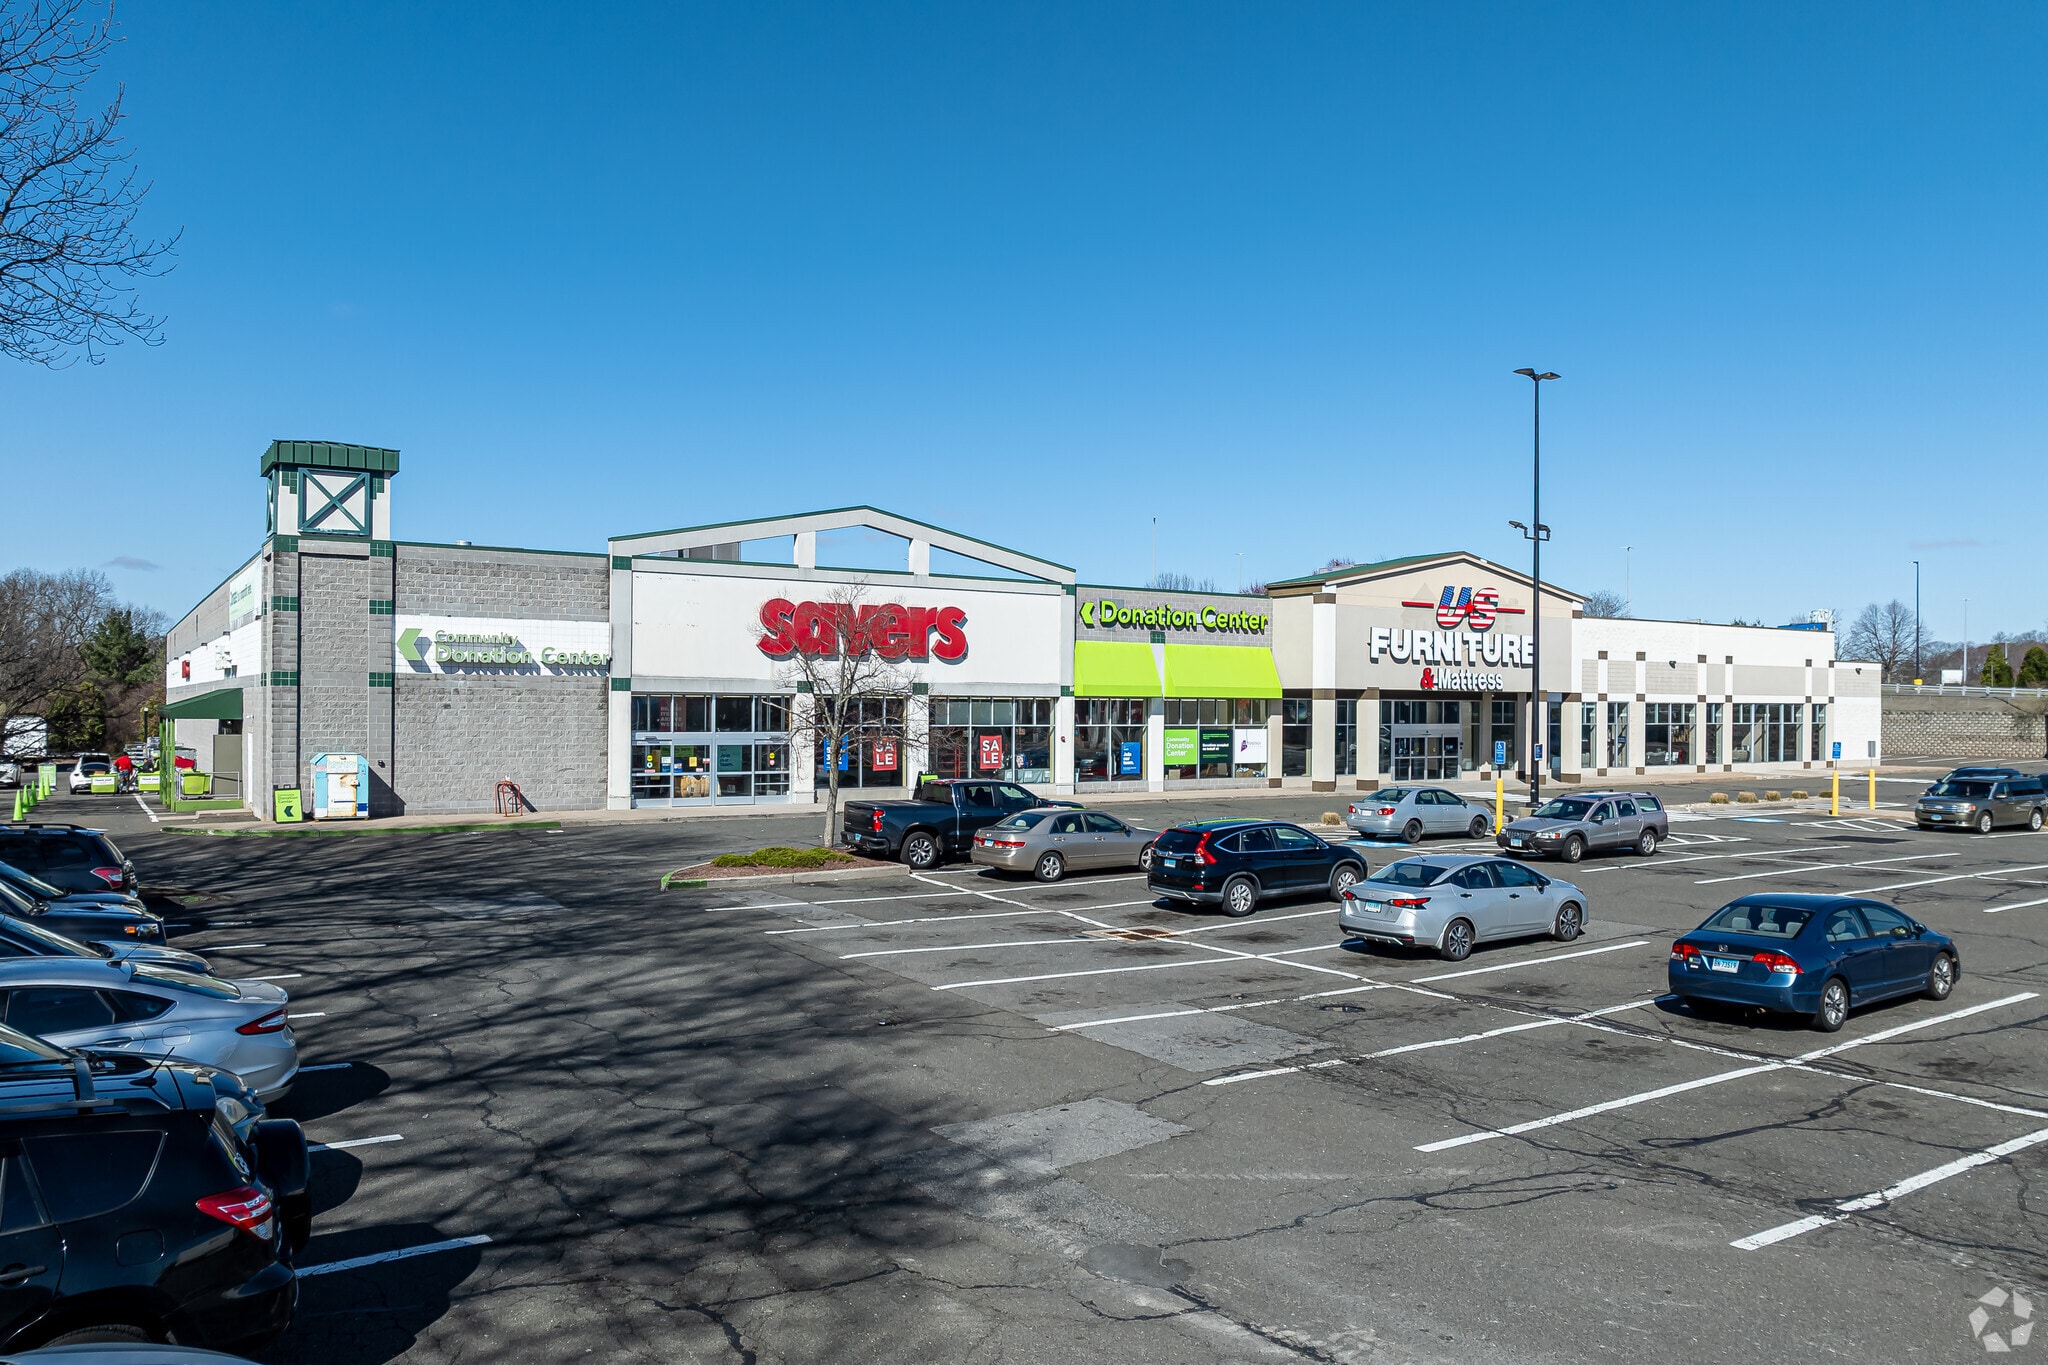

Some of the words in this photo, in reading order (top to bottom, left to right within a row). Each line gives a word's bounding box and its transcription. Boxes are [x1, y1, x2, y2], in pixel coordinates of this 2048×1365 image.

[1101, 600, 1197, 626] Donation
[1202, 605, 1269, 630] Center
[1436, 585, 1500, 630] US
[435, 630, 518, 647] Community
[1370, 626, 1534, 666] FURNITURE
[435, 644, 533, 664] Donation
[541, 646, 611, 665] Center
[982, 740, 1000, 751] SA
[1166, 749, 1187, 757] Center
[876, 753, 894, 766] LE
[982, 752, 999, 764] LE
